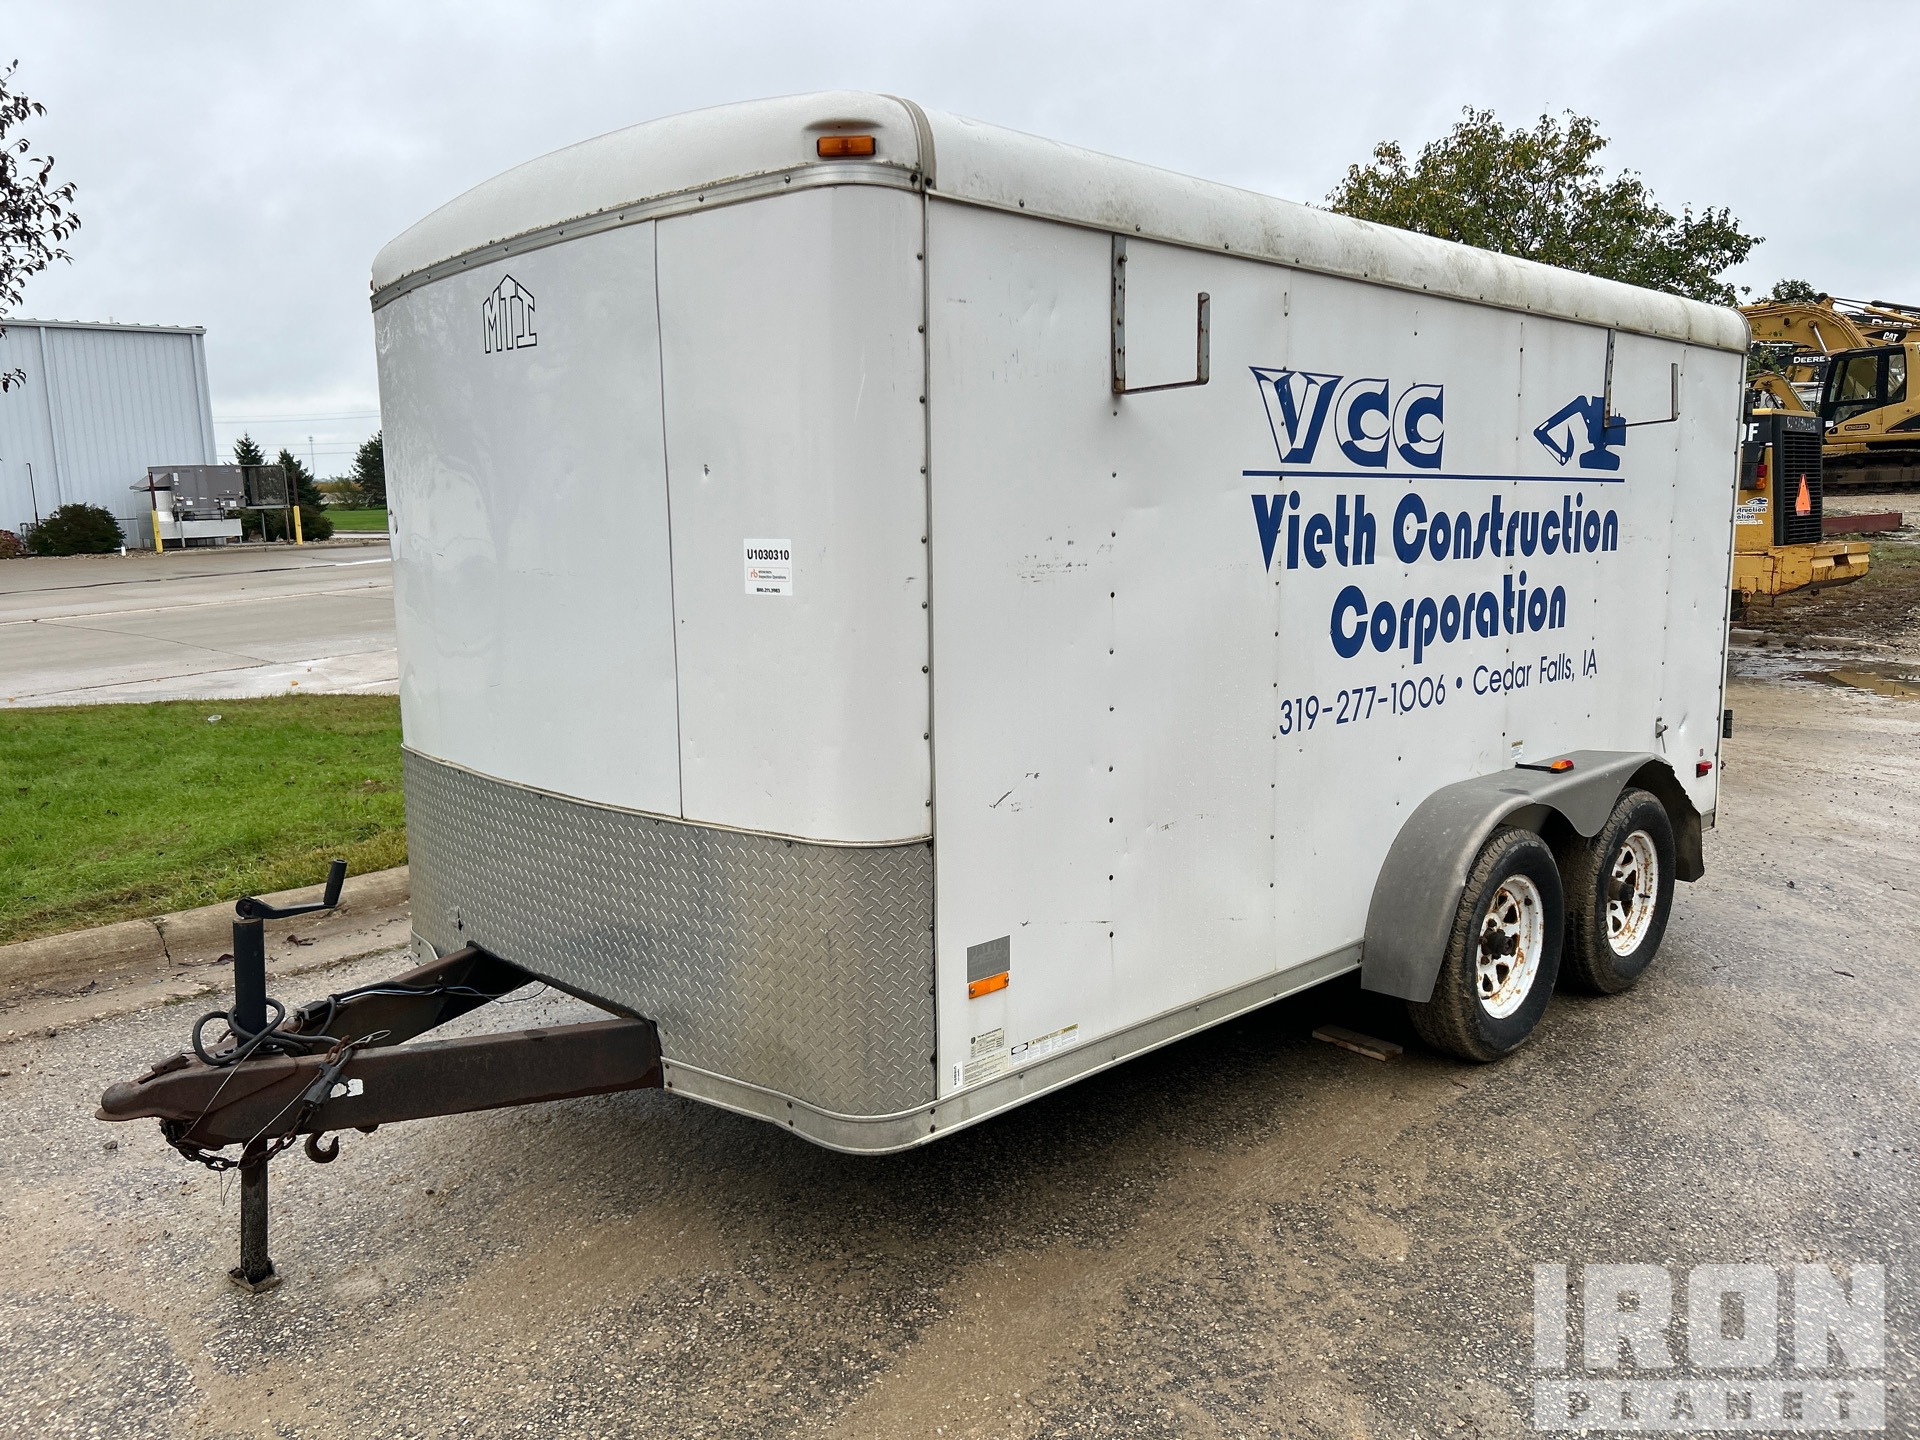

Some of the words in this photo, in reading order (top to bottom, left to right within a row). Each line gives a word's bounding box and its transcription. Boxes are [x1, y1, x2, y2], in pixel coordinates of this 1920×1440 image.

[1871, 319, 1918, 328] DEER
[1882, 331, 1899, 342] CAT
[1793, 356, 1826, 364] DEERE
[1248, 366, 1445, 470] VCC
[747, 548, 790, 560] U1030310
[1251, 490, 1376, 574] Vieth
[1393, 492, 1618, 564] Construction
[1330, 570, 1565, 664] Corporation
[1279, 674, 1446, 735] 319-277-1006
[1473, 662, 1532, 695] Cedar
[1539, 653, 1575, 684] Falls,
[1583, 649, 1598, 676] IA
